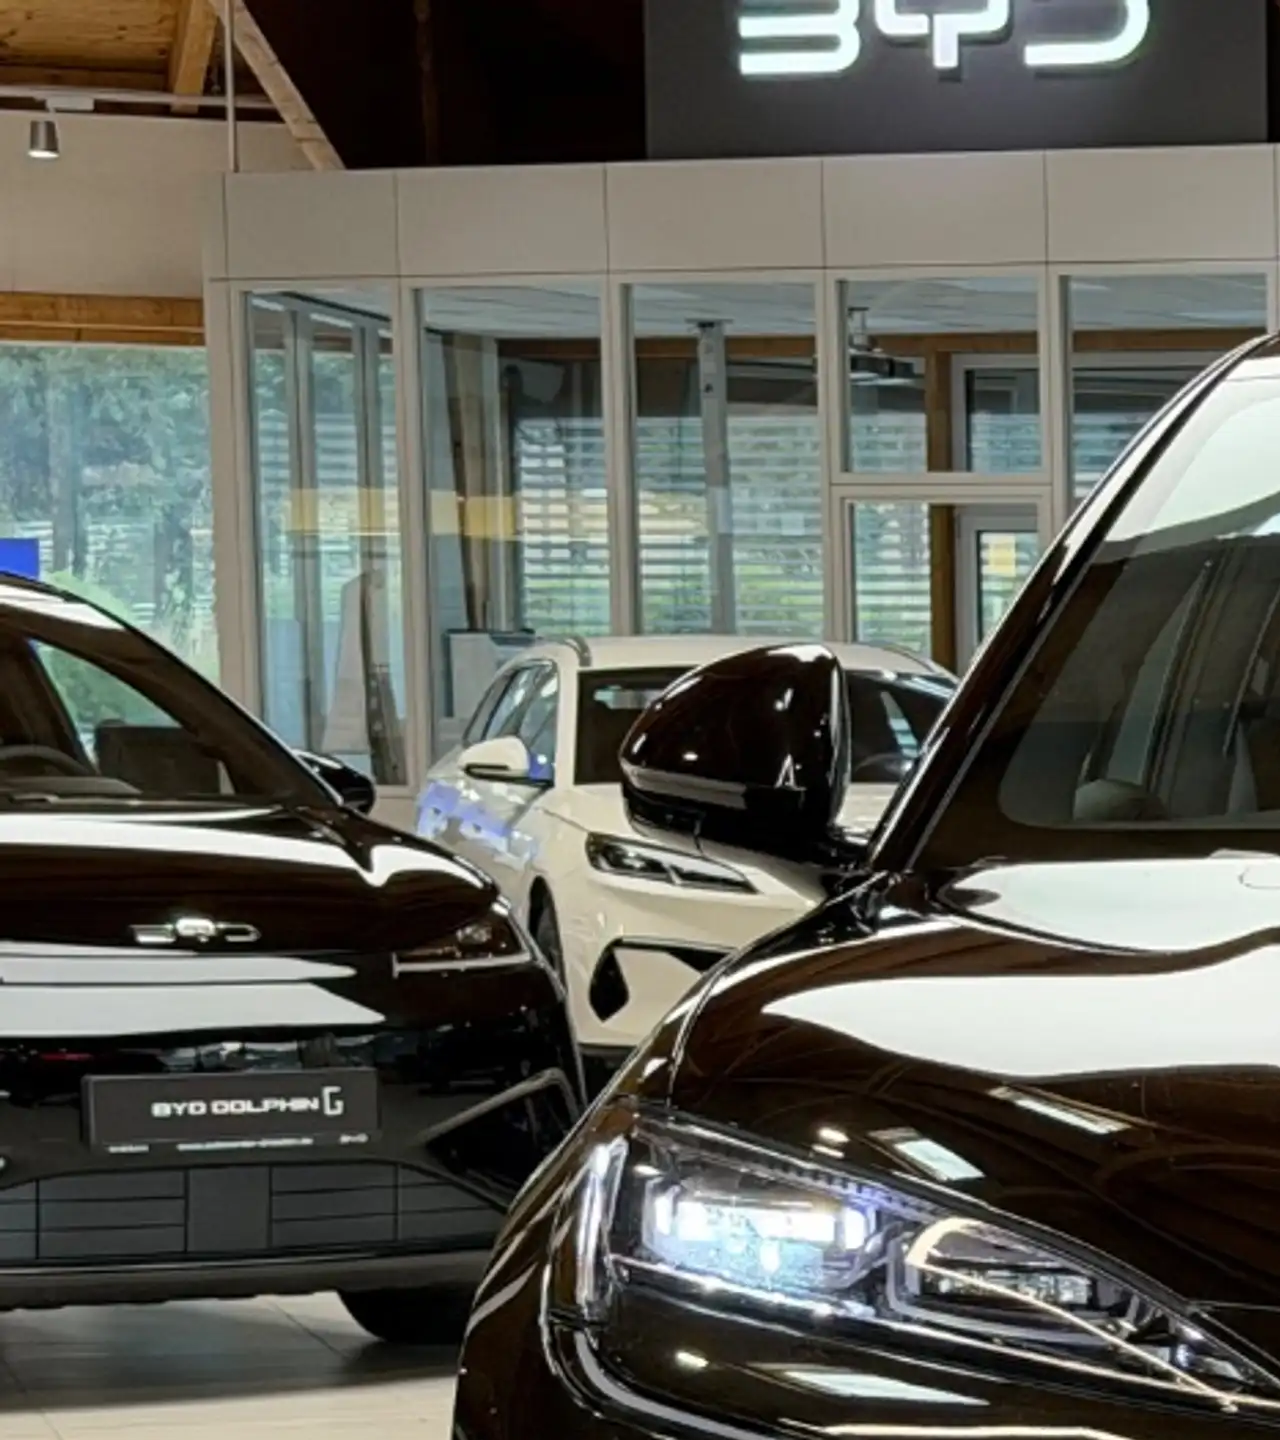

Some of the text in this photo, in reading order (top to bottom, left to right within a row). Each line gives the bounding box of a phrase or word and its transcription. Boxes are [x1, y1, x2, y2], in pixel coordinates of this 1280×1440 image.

[737, 0, 1151, 77] BYD
[151, 1101, 207, 1118] BYD
[210, 1096, 319, 1116] DOLPHIN
